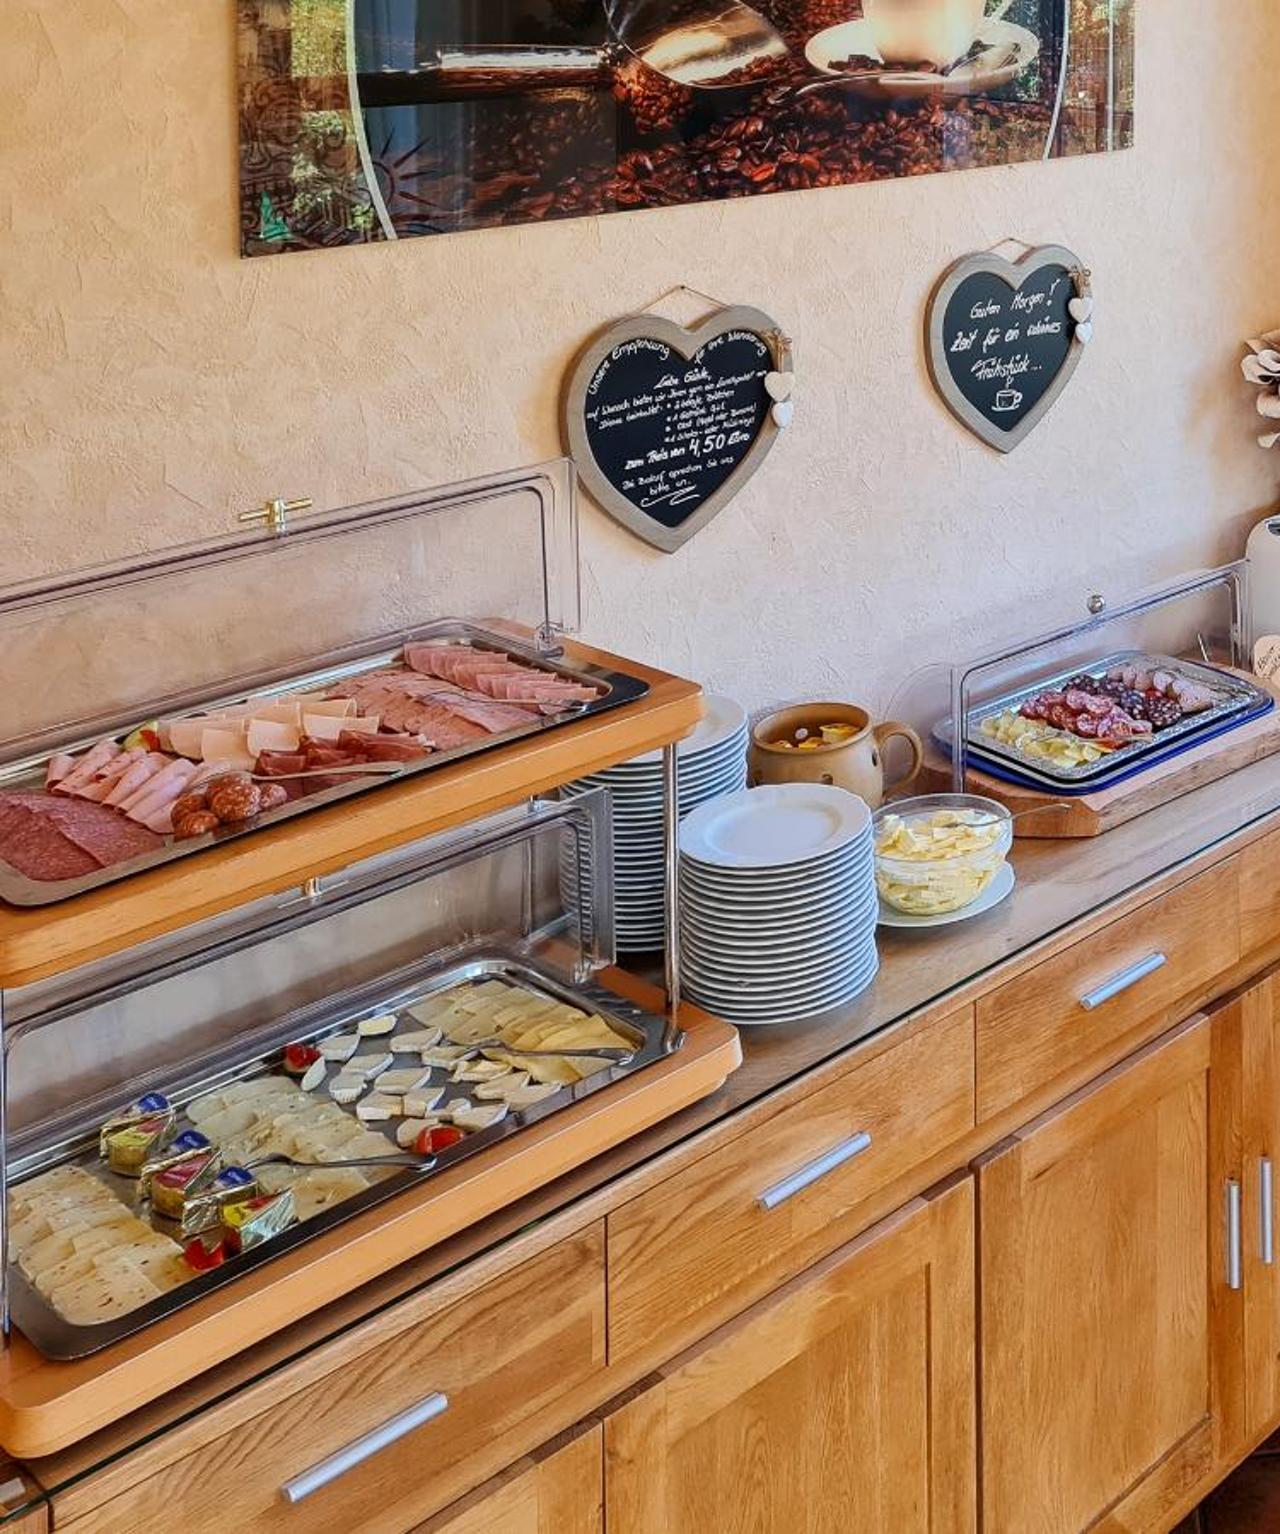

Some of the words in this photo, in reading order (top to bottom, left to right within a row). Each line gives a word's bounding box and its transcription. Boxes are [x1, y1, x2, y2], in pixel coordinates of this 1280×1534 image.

[970, 299, 1001, 319] Guten
[982, 327, 1002, 353] für
[1004, 322, 1020, 342] ein
[588, 360, 610, 395] Unsere
[612, 338, 670, 360] Empfehlung
[652, 373, 680, 389] Liebe
[602, 398, 631, 416] Wunsch
[654, 392, 667, 403] wir
[624, 459, 644, 470] zum
[647, 447, 669, 463] Preis
[689, 433, 726, 458] 4,50
[726, 430, 751, 446] Euro
